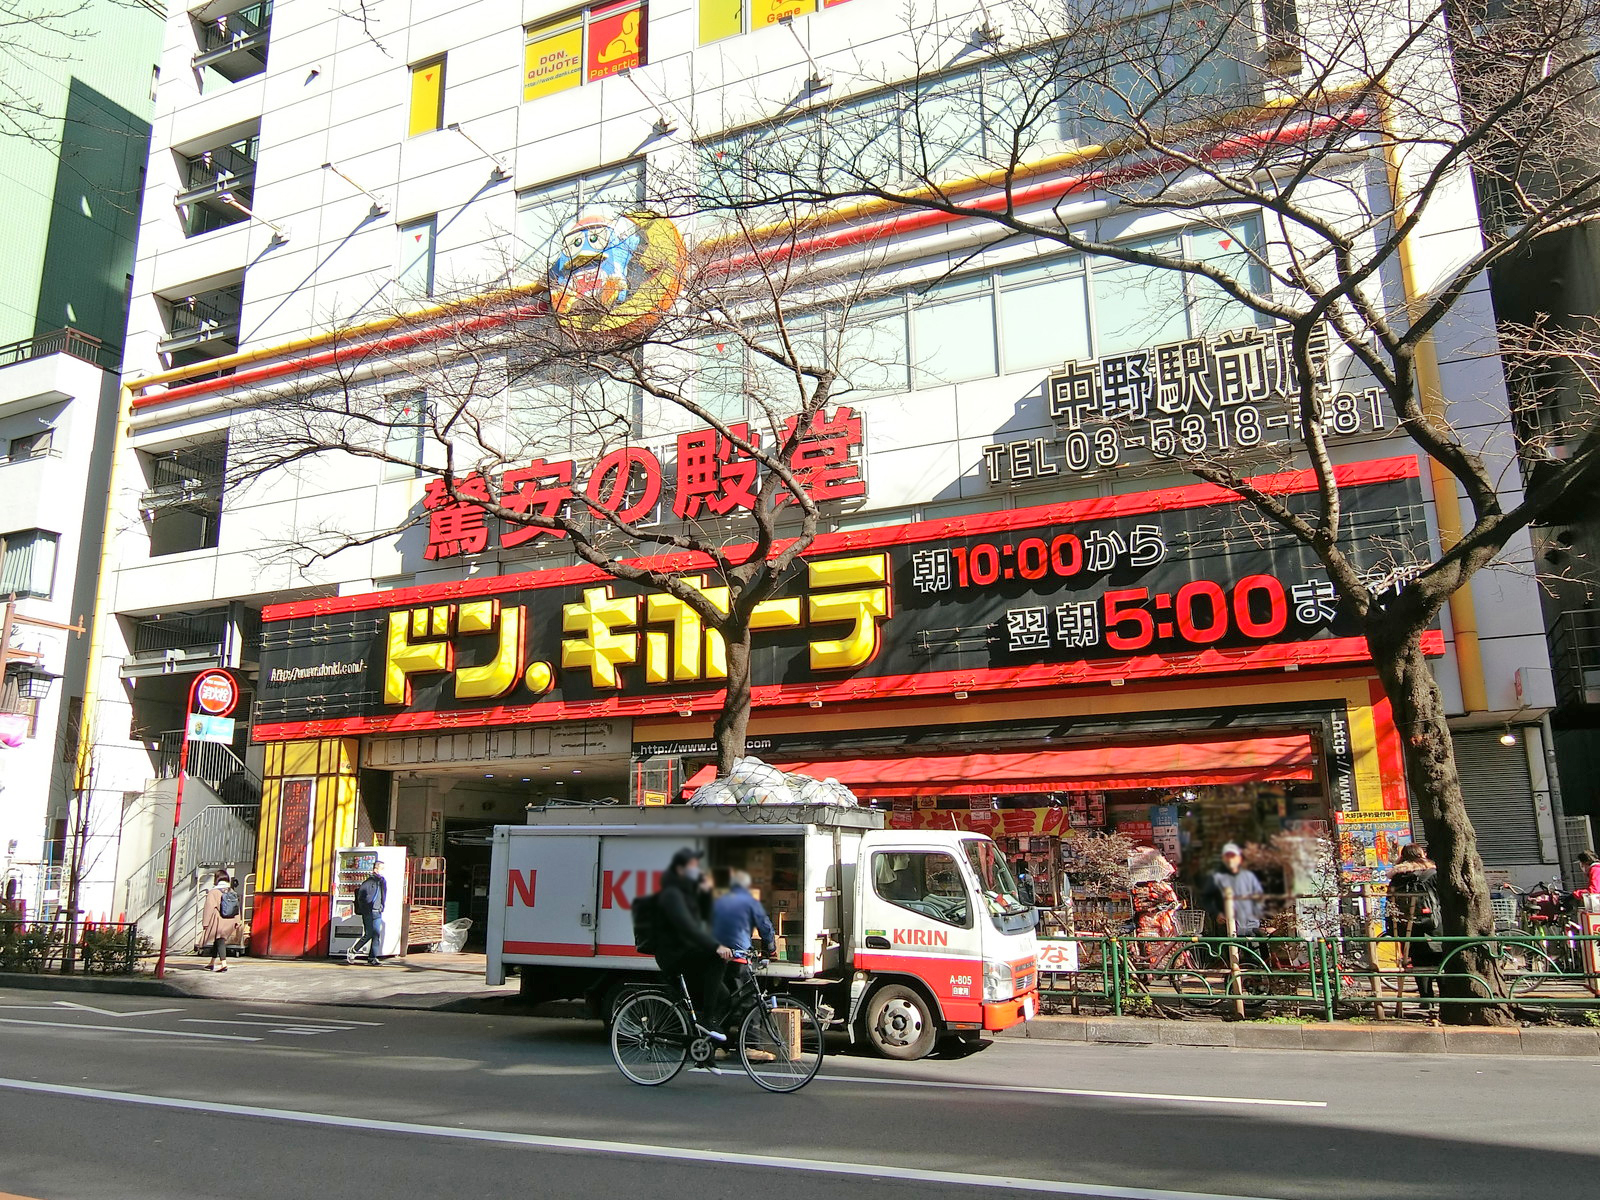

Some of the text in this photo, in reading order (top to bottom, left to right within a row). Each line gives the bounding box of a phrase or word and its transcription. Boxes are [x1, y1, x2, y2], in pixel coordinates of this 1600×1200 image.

[767, 7, 801, 24] Game
[540, 50, 568, 66] DON.
[527, 56, 579, 80] QUIJOTE
[590, 66, 608, 80] Pet
[982, 386, 1385, 484] TEL 03-5318-81
[422, 406, 867, 561] 驚安の殿堂
[912, 524, 1167, 594] 朝10:00から
[640, 738, 772, 756] http://www.d.com
[506, 869, 537, 908] N
[893, 928, 948, 946] KIRIN
[1040, 944, 1069, 963] な
[950, 974, 972, 985] A-805
